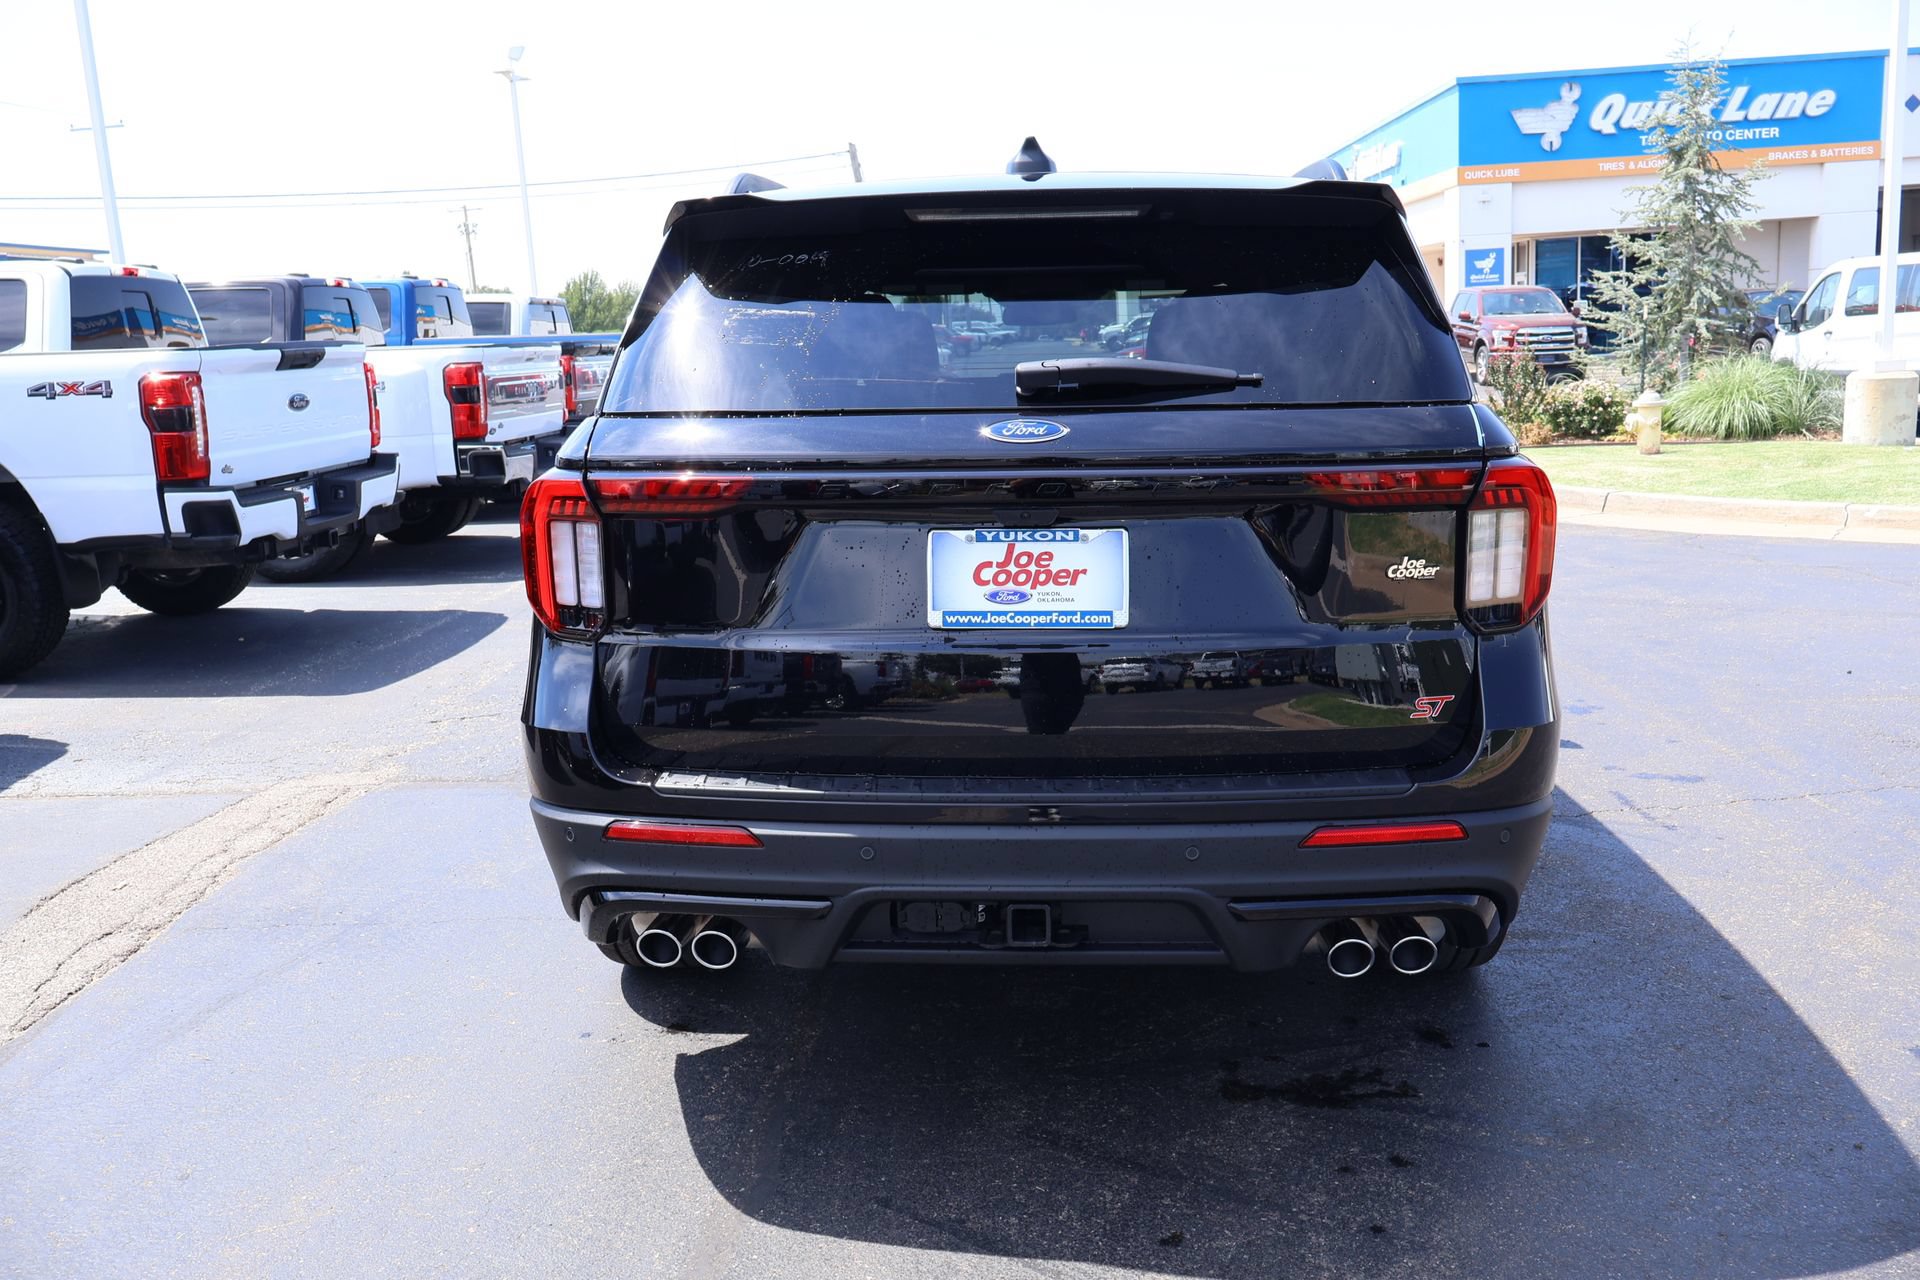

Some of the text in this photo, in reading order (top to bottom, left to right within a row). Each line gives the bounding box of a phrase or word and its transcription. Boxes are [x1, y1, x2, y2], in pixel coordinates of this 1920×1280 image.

[1720, 86, 1837, 122] Lane
[1725, 127, 1780, 141] CENTER
[1768, 146, 1874, 161] BRAKES & BATTERIES
[1599, 160, 1625, 171] TIRES
[1629, 160, 1636, 170] &
[1464, 168, 1521, 179] QUICK LUBE
[1002, 421, 1048, 436] Ford
[982, 530, 1075, 541] YUKON
[995, 543, 1054, 569] Joe
[1398, 556, 1426, 570] Joe
[972, 561, 1088, 590] Cooper
[1387, 564, 1440, 579] Cooper
[996, 590, 1020, 602] Ford
[945, 612, 1112, 627] www.JoeCooperFord.com
[1410, 695, 1455, 719] ST
